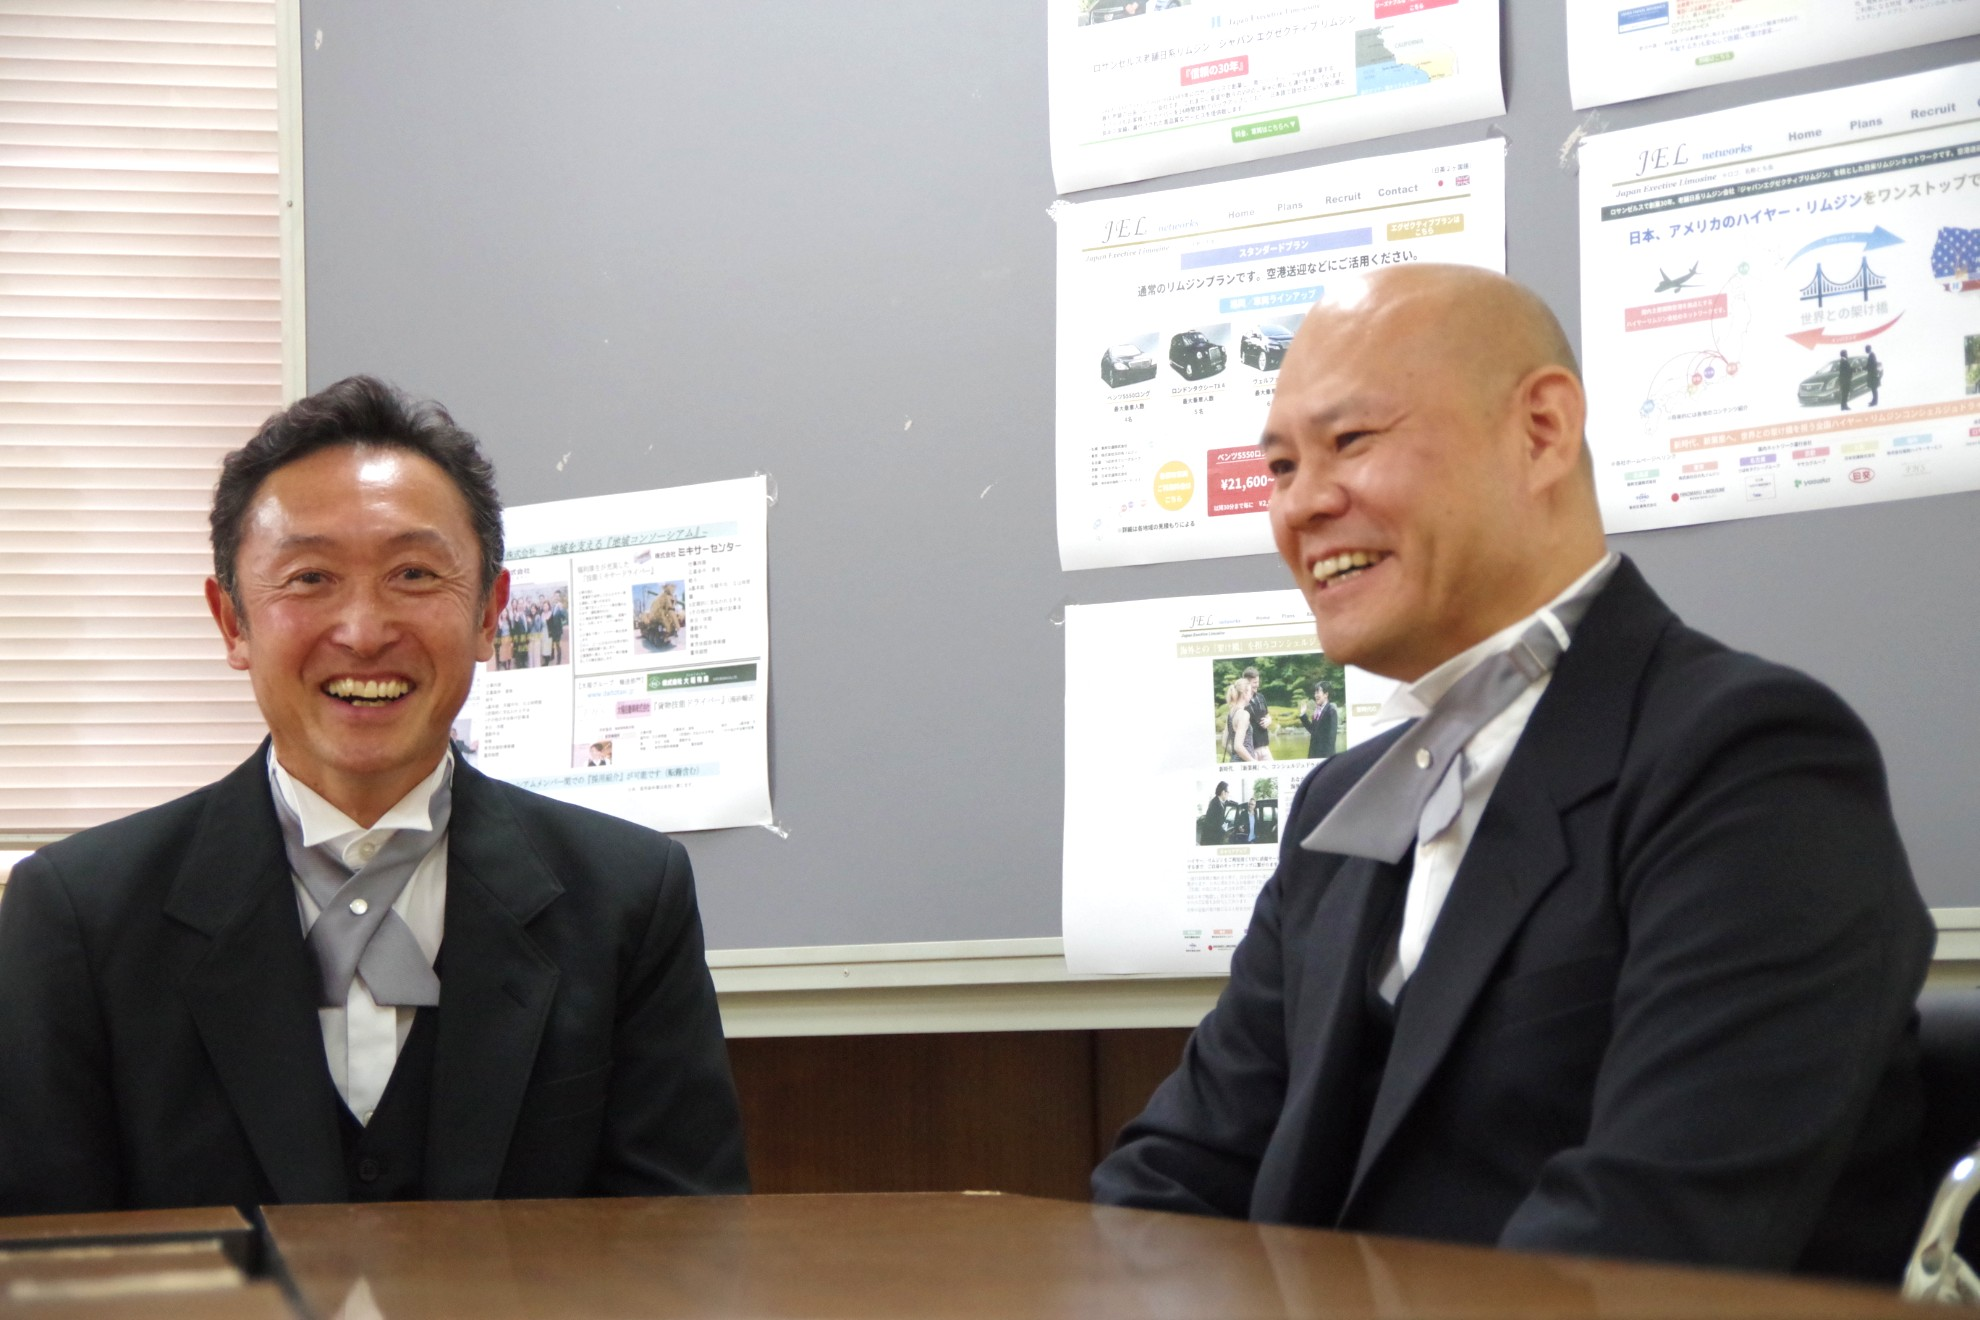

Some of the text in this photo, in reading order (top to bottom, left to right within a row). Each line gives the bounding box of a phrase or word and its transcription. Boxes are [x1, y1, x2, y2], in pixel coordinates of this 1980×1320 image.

[1788, 102, 1957, 142] Home Plans Recruit
[1636, 143, 1753, 176] JEL networks
[1228, 184, 1419, 220] Home Plans Recruit Contact
[1102, 216, 1147, 244] JEL
[1800, 301, 1888, 326] 世界との架け橋
[678, 542, 742, 557] ミキサーセンター
